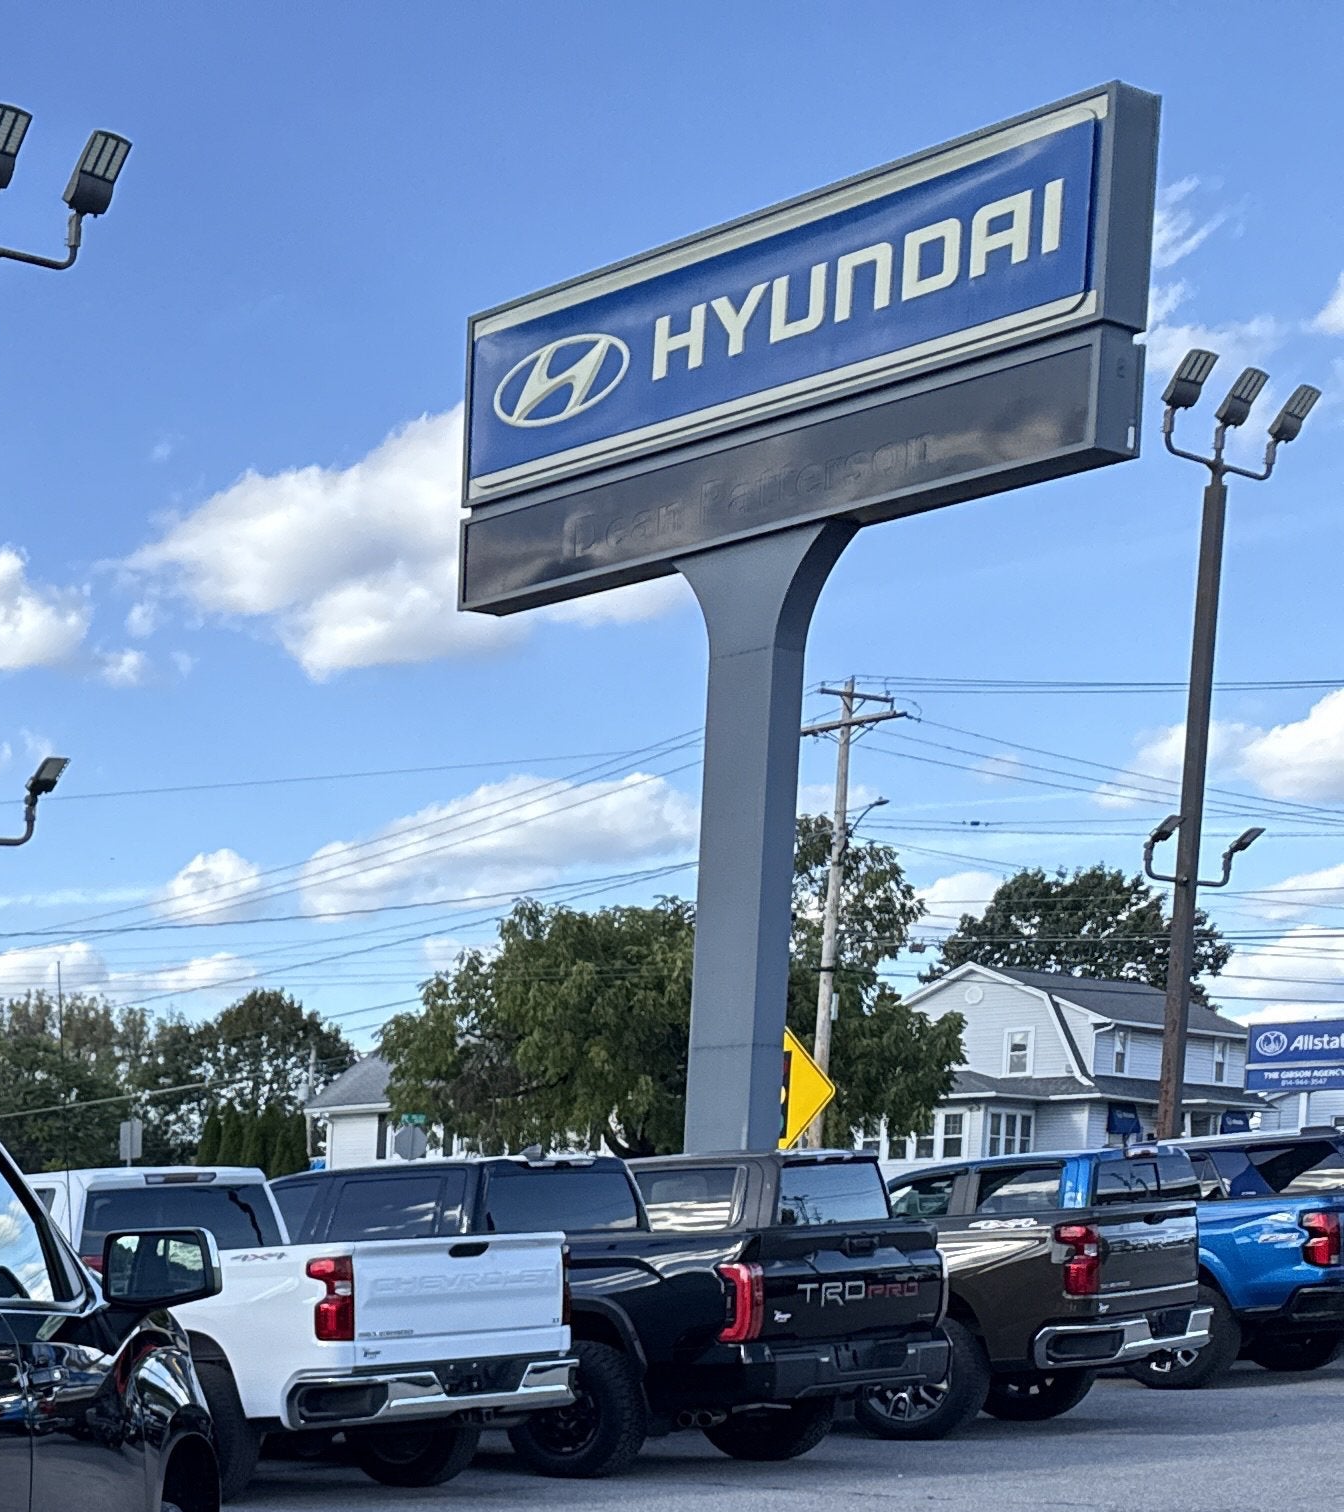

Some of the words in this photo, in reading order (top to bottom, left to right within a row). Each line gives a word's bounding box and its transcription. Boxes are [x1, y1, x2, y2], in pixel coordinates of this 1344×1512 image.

[651, 177, 1065, 382] HYUNDAI
[797, 1281, 866, 1307] TRD
[867, 1282, 920, 1300] PRO
